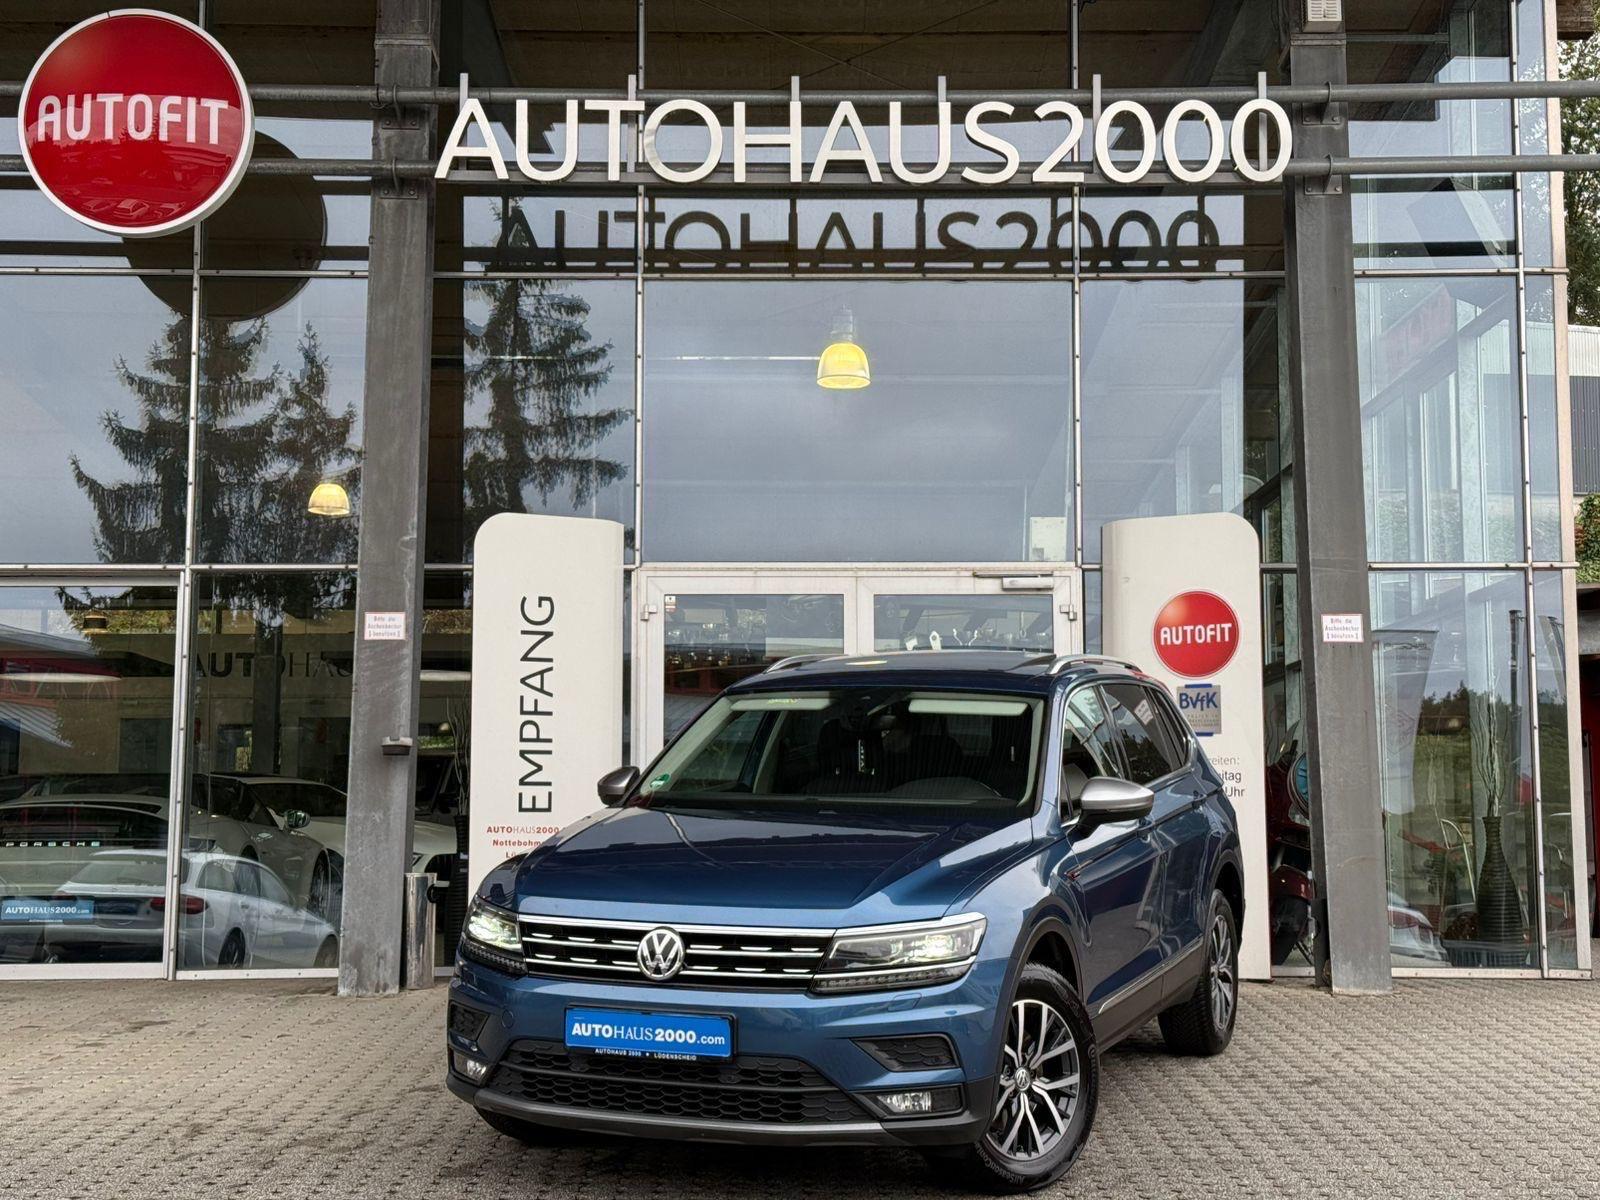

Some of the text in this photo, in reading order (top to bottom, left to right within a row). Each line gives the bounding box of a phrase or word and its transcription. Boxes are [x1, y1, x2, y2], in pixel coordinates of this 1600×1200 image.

[37, 92, 229, 145] AUTOFIT
[434, 98, 1292, 184] AUTOHAUS2000
[1160, 623, 1232, 645] AUTOFIT
[518, 595, 555, 813] EMPFANG
[1210, 756, 1240, 765] eiten:
[1219, 770, 1241, 783] itag
